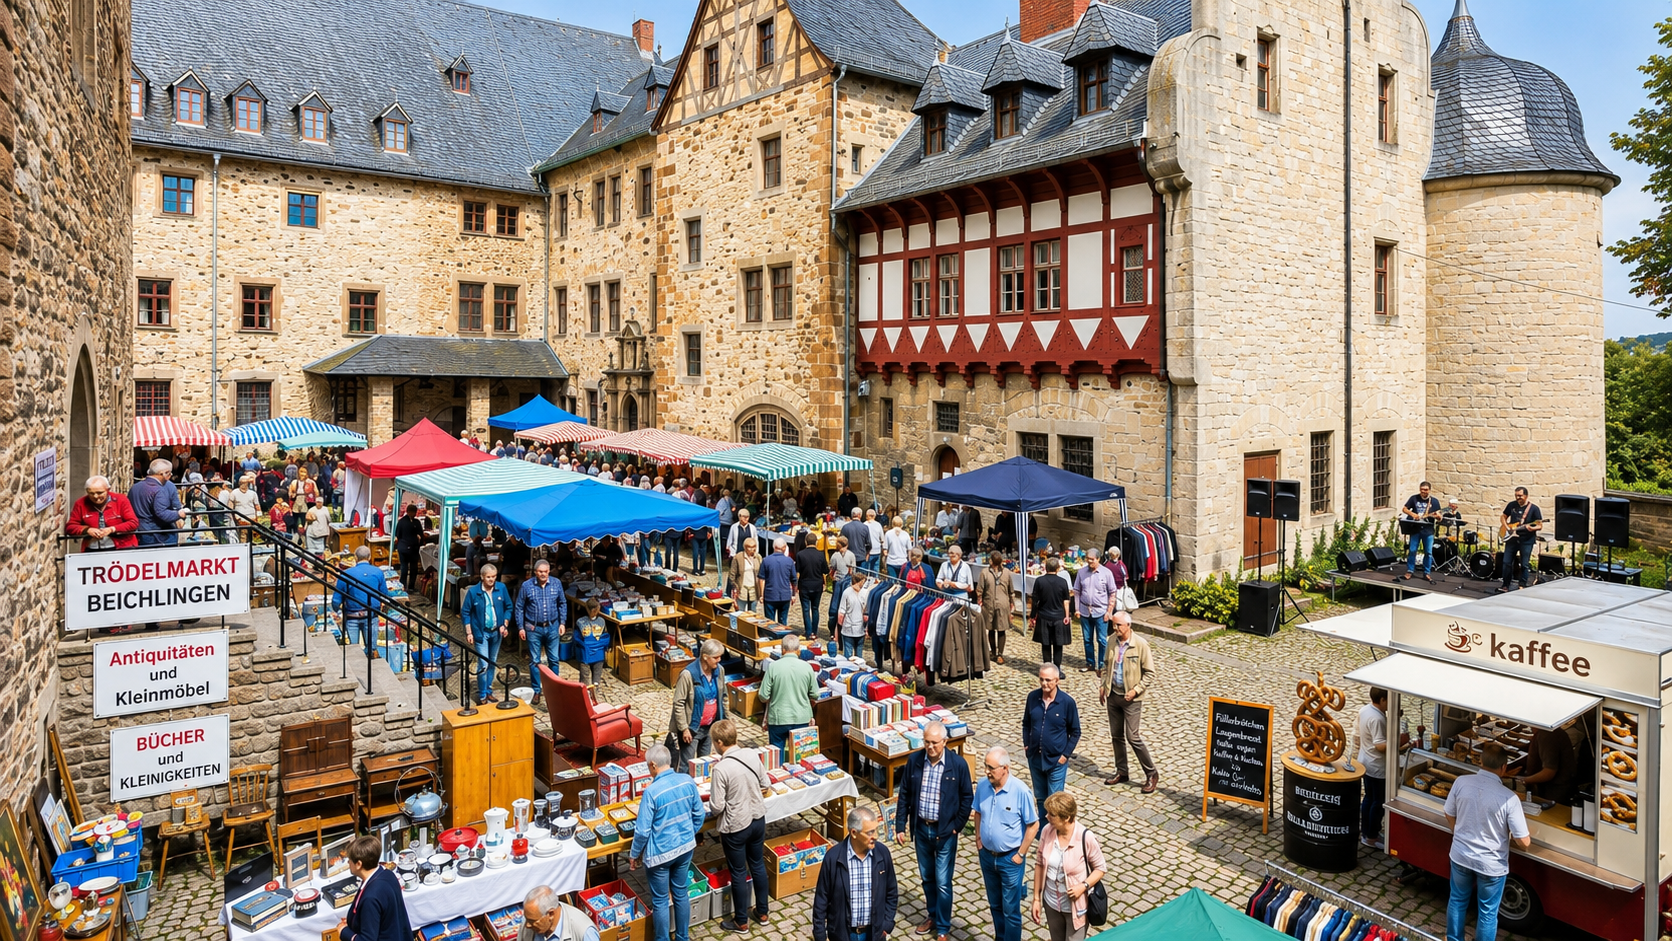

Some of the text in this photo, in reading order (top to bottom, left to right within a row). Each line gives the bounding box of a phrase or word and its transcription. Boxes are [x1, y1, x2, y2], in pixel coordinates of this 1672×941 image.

[77, 556, 240, 585] TRÖDELMARKT
[87, 583, 230, 613] BEICHLINGEN
[109, 643, 215, 667] Antiquitäten
[1490, 633, 1591, 677] kaffee
[149, 666, 177, 681] und
[115, 681, 210, 706] Kleinmöbel
[136, 728, 205, 751] BÜCHER
[158, 751, 184, 766] und
[120, 763, 221, 790] KLEINIGKEITEN
